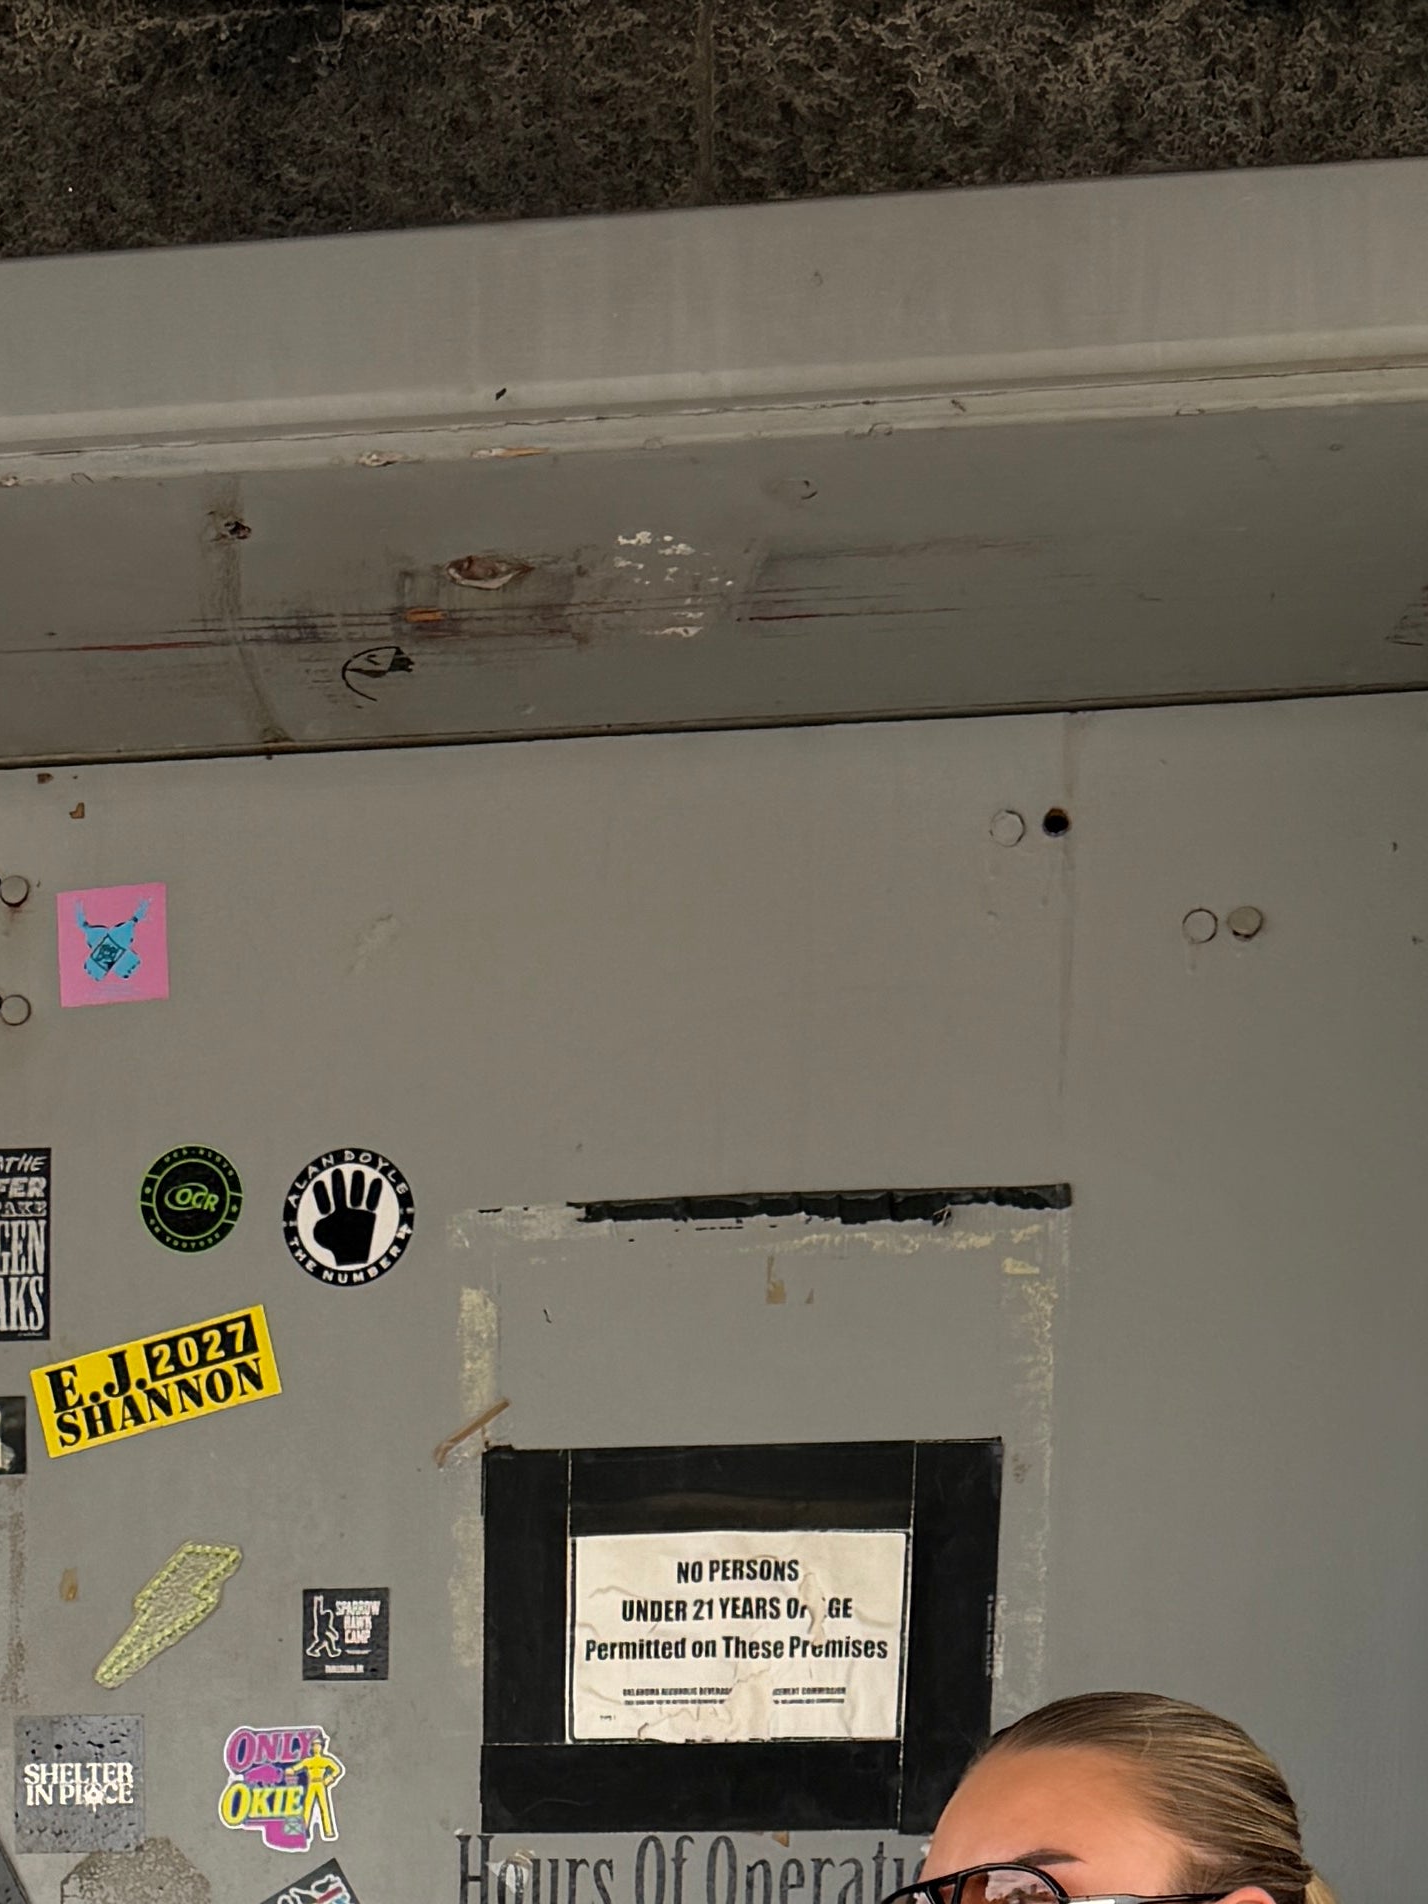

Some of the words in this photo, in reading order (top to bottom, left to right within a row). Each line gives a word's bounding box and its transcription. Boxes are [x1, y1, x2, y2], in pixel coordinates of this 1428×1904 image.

[288, 1153, 335, 1208] ALAN
[344, 1150, 409, 1195] DOYLE
[175, 1187, 219, 1212] OCR
[289, 1236, 317, 1272] THE
[322, 1245, 401, 1284] NUMBER
[45, 1350, 147, 1414] E.J.
[151, 1321, 247, 1376] 2027
[56, 1358, 264, 1448] SHANNON
[677, 1561, 703, 1584] NO
[709, 1559, 799, 1582] PERSONS
[622, 1599, 687, 1622] UNDER
[693, 1598, 714, 1620] 21
[719, 1597, 780, 1619] YEARS
[585, 1637, 687, 1661] Permitted
[691, 1639, 717, 1658] on
[722, 1636, 784, 1659] These
[789, 1635, 888, 1659] Premises
[227, 1730, 319, 1773] ONLY
[23, 1762, 133, 1784] SHELTER
[26, 1783, 54, 1806] IN
[222, 1782, 304, 1825] OKIE
